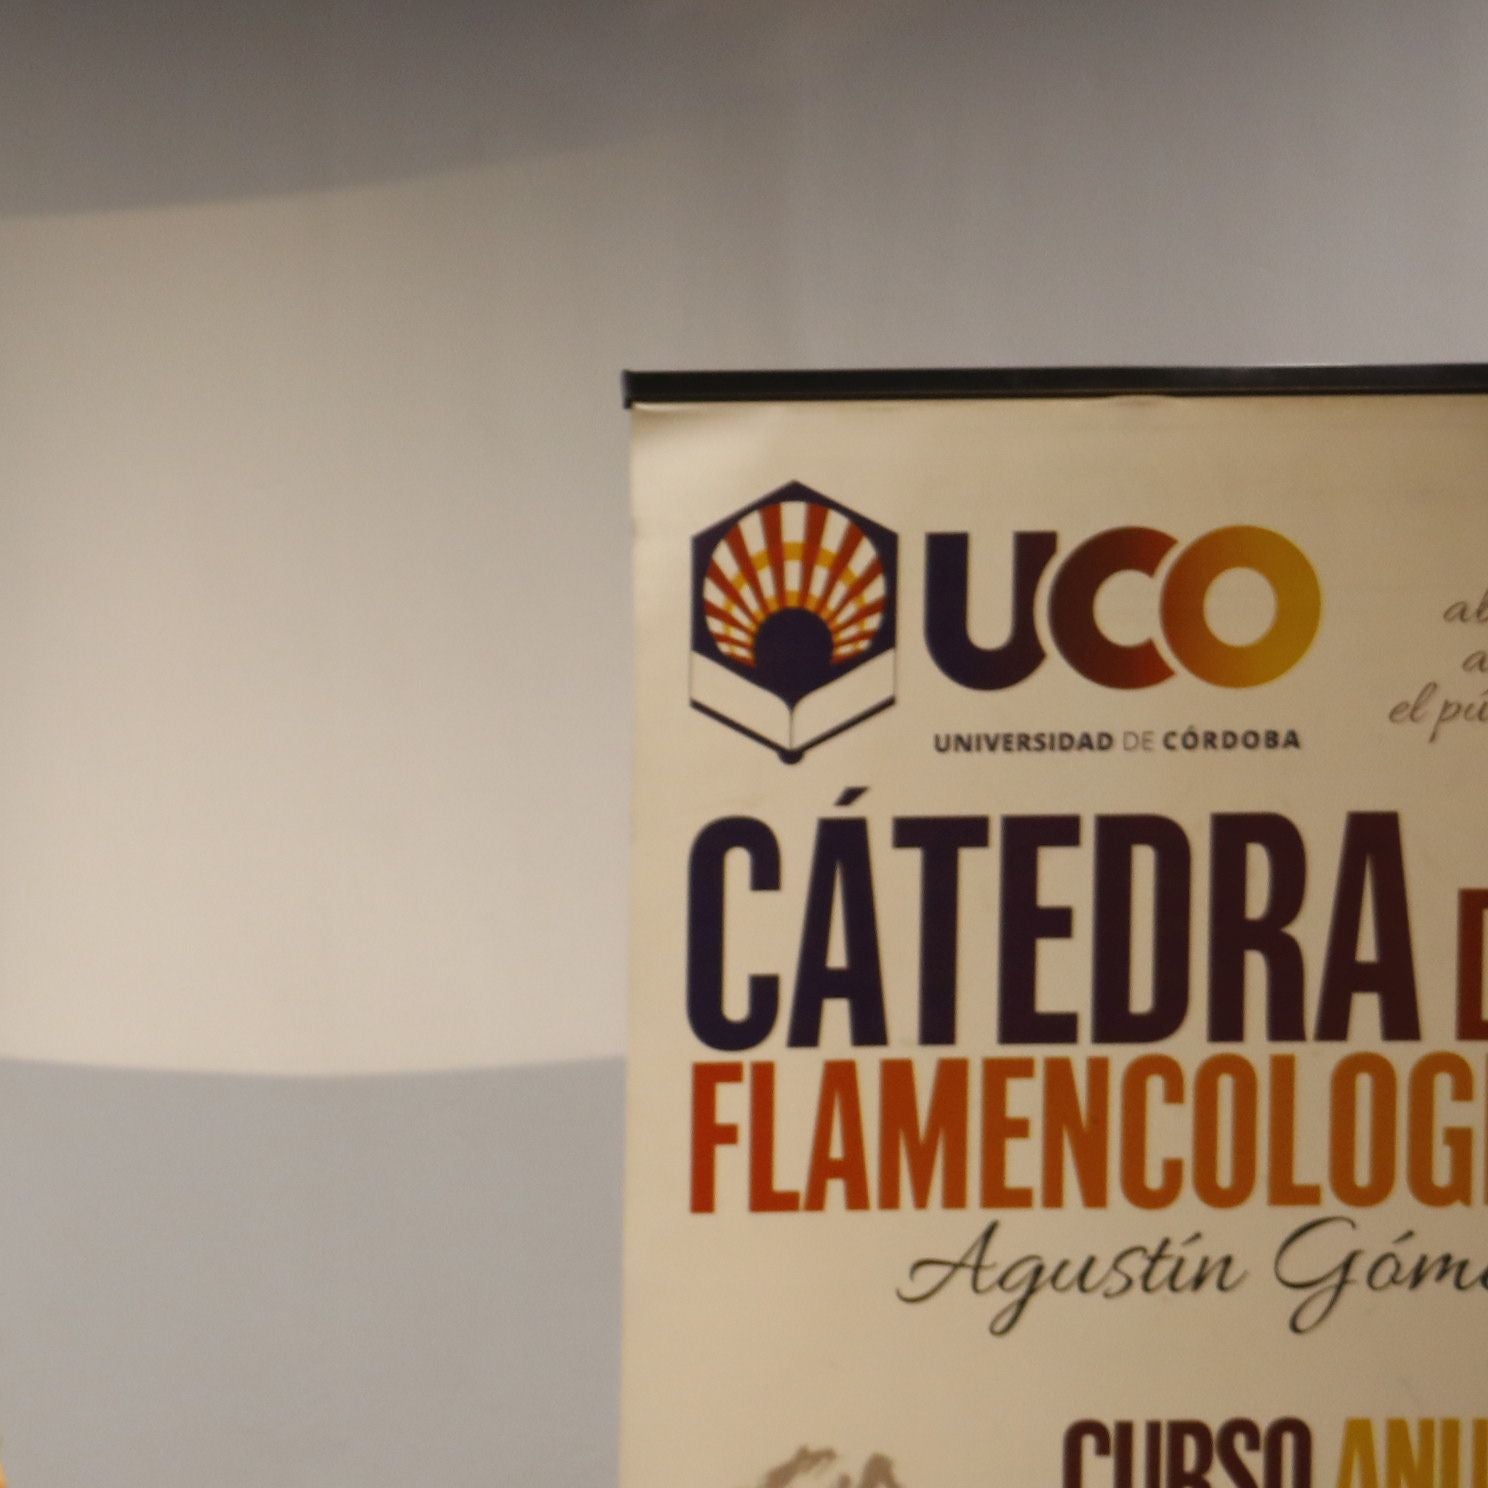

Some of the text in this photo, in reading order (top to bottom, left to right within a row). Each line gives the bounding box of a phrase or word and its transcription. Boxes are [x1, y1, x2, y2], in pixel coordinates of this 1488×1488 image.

[923, 524, 1324, 691] UCO
[933, 724, 1302, 753] UNIVERSIDAD DE CÓRDOBA
[685, 785, 1422, 1052] CÁTEDRA
[689, 1050, 1488, 1214] FLAMENCOLOG
[896, 1219, 1250, 1337] Agustín
